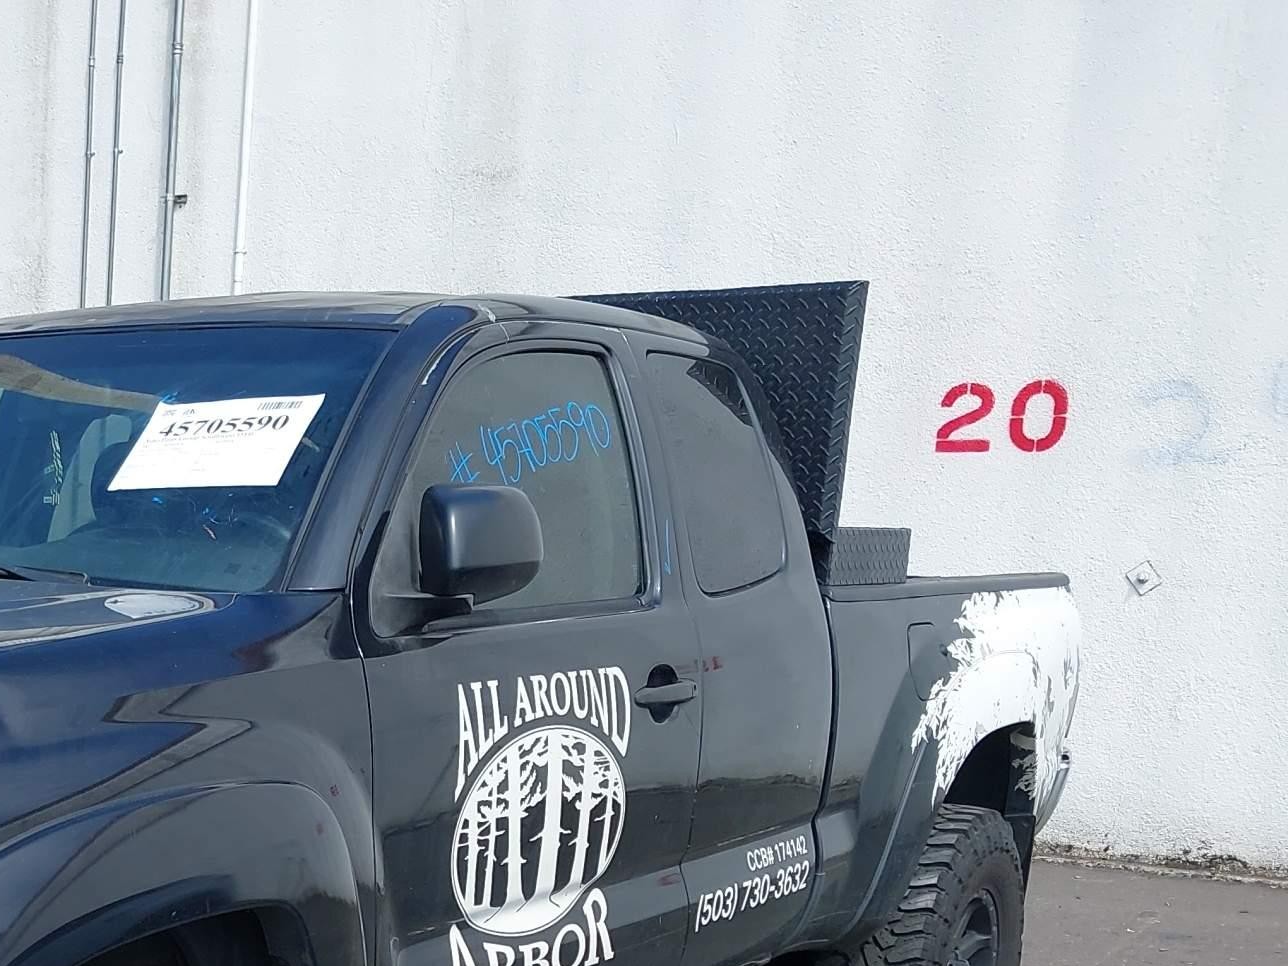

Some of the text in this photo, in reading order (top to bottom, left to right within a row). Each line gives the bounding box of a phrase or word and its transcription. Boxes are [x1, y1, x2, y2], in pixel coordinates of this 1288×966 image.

[159, 414, 290, 437] 45705590
[479, 400, 611, 486] 45705590
[935, 380, 1069, 453] 20
[454, 665, 631, 802] ALL AROUND
[746, 835, 808, 872] CCB# 174142
[695, 860, 810, 933] (503) 730-3632
